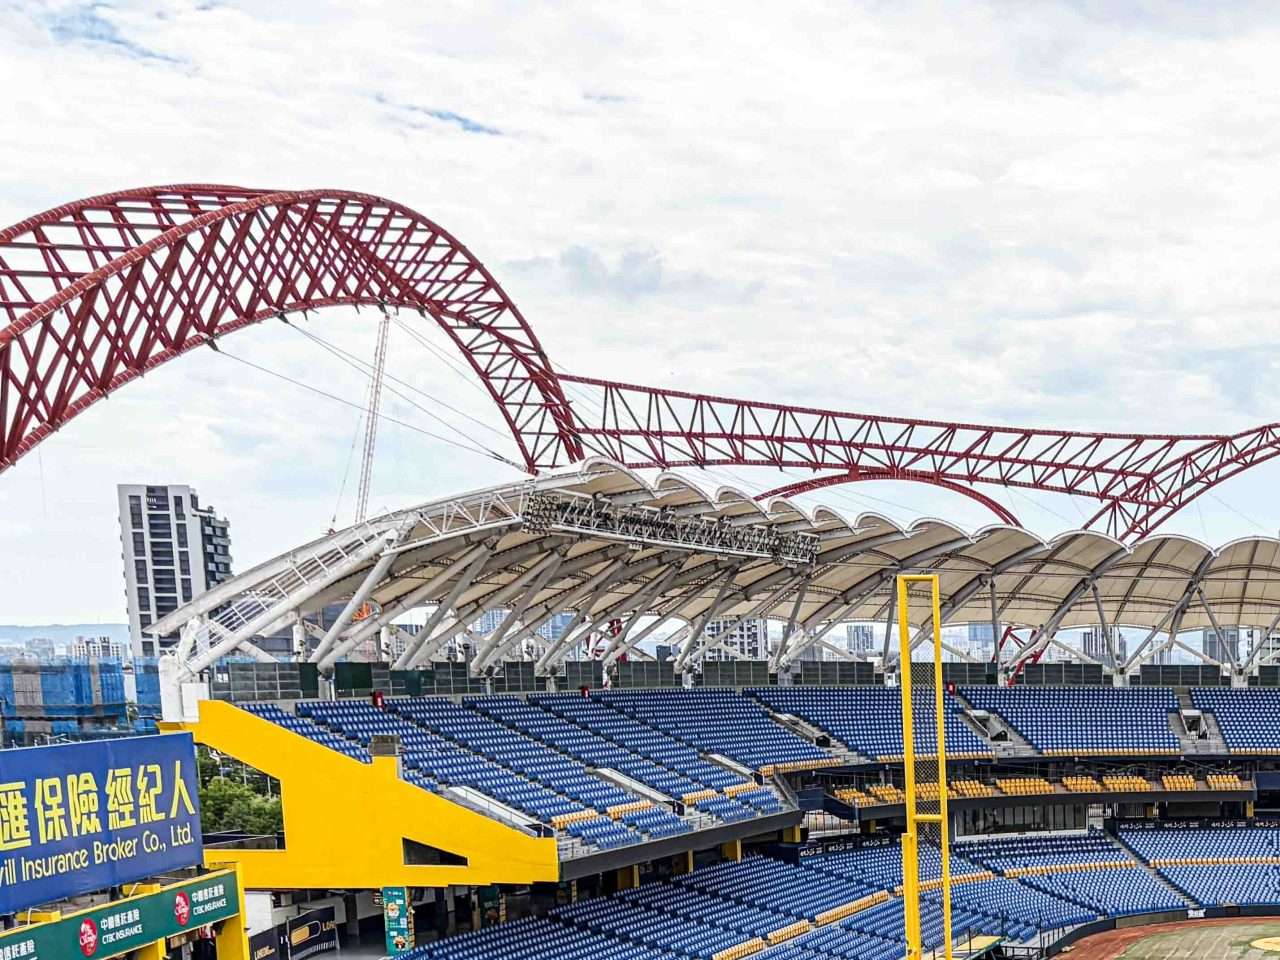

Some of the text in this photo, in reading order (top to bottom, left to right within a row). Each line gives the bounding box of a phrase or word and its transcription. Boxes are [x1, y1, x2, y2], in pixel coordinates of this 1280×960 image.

[21, 849, 89, 882] Insurance
[93, 837, 138, 865] Broker
[142, 830, 167, 853] Co.,
[170, 822, 194, 847] Ltd.
[204, 898, 227, 912] INSURANCE
[116, 924, 143, 941] INSURANCE
